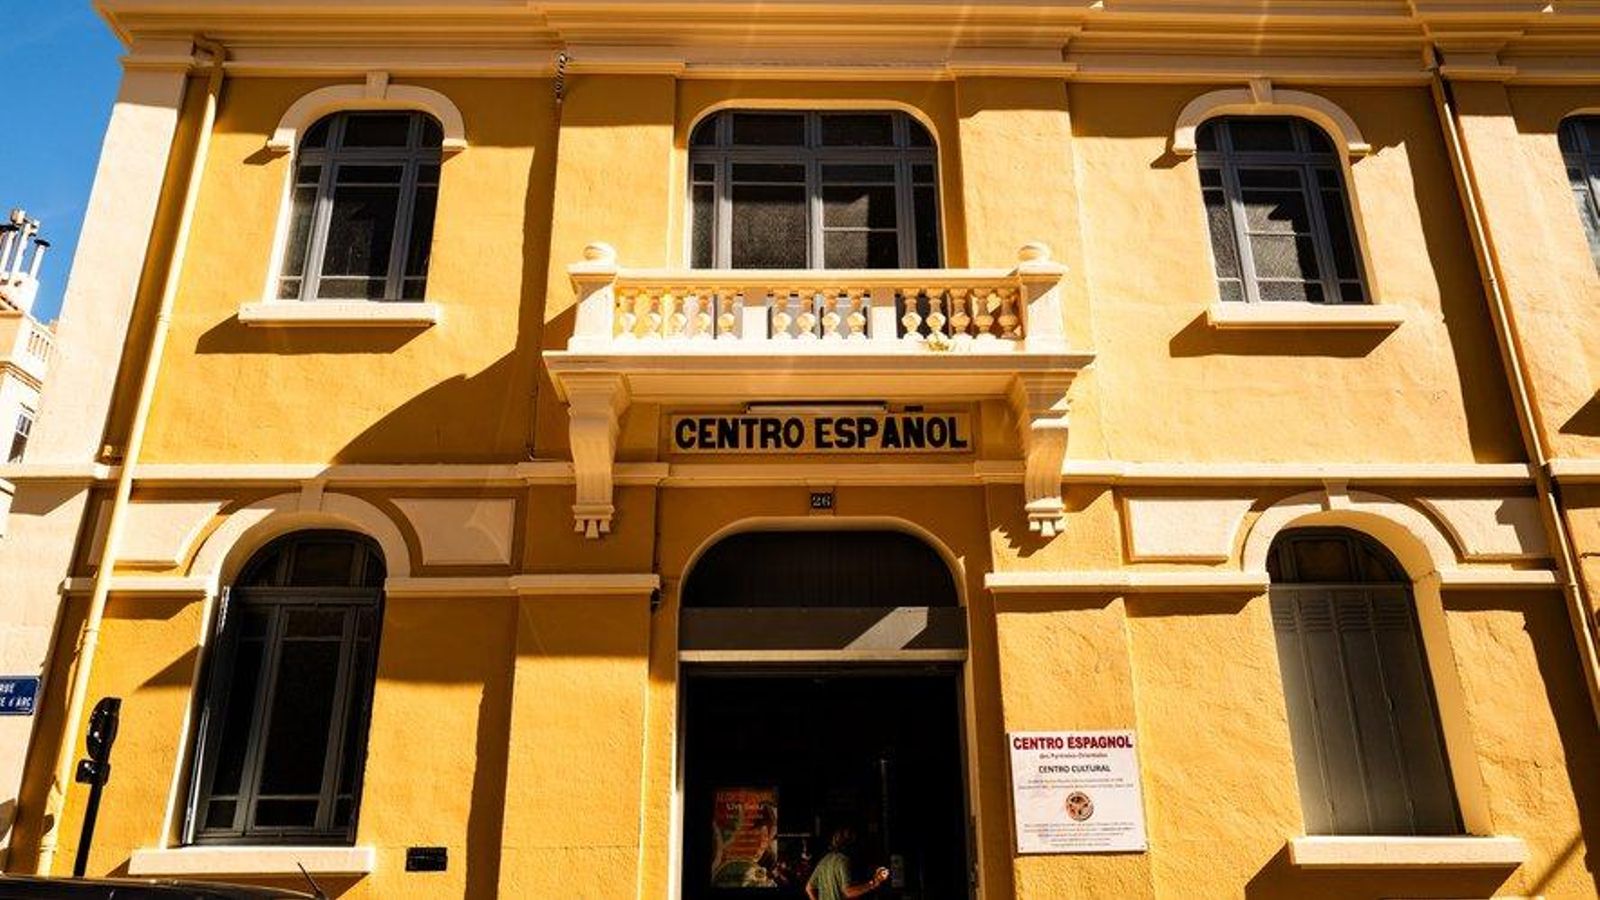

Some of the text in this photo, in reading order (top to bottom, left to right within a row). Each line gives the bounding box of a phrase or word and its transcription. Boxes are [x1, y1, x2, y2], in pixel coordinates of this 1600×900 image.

[675, 405, 968, 450] CENTRO ESPAÑOL
[812, 495, 832, 508] 26
[1013, 735, 1133, 750] CENTRO ESPAGNOL
[1038, 764, 1111, 774] CENTRO CULTURAL
